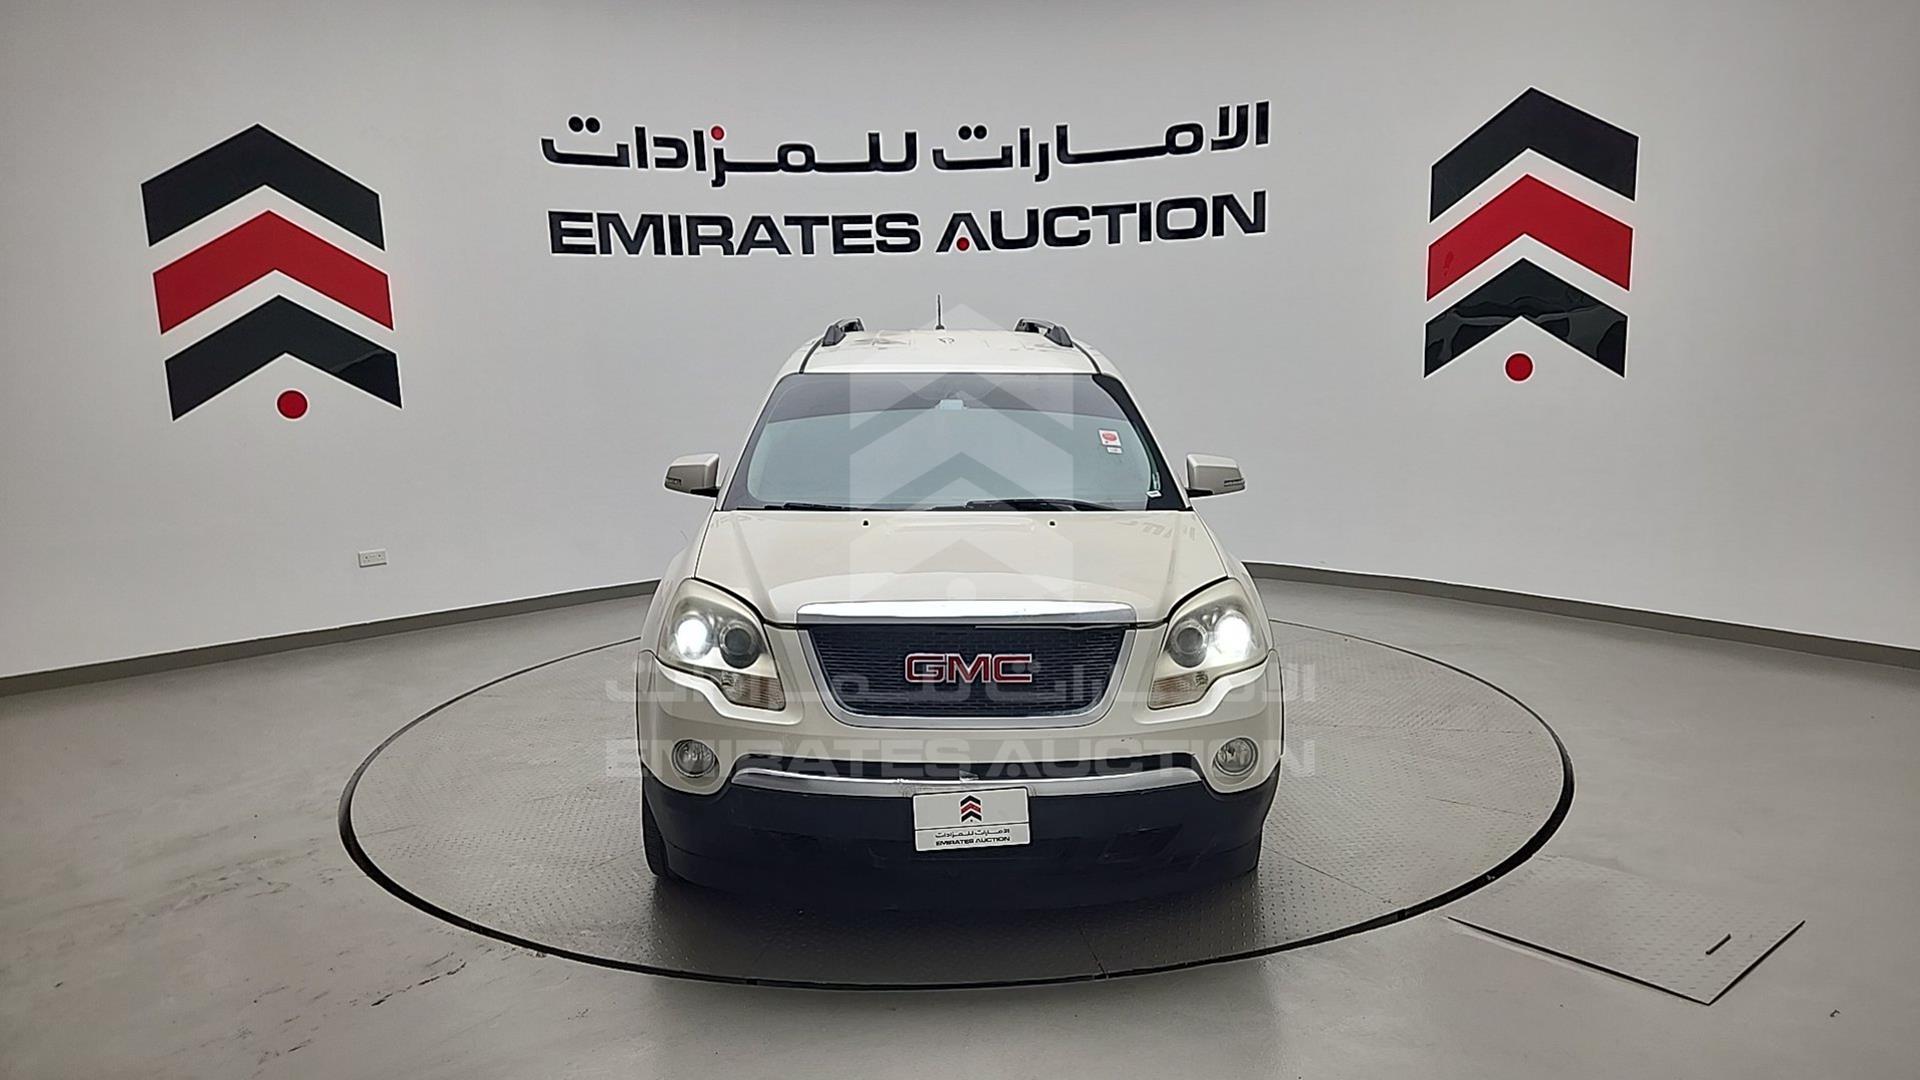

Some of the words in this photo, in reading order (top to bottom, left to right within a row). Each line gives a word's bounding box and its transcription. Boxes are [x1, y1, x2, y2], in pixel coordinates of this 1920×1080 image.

[541, 115, 918, 188] للمزادات
[932, 101, 1270, 182] الامارات
[548, 210, 922, 256] EMIRATES
[935, 190, 1266, 253] AUCTION
[905, 653, 1032, 683] GMC
